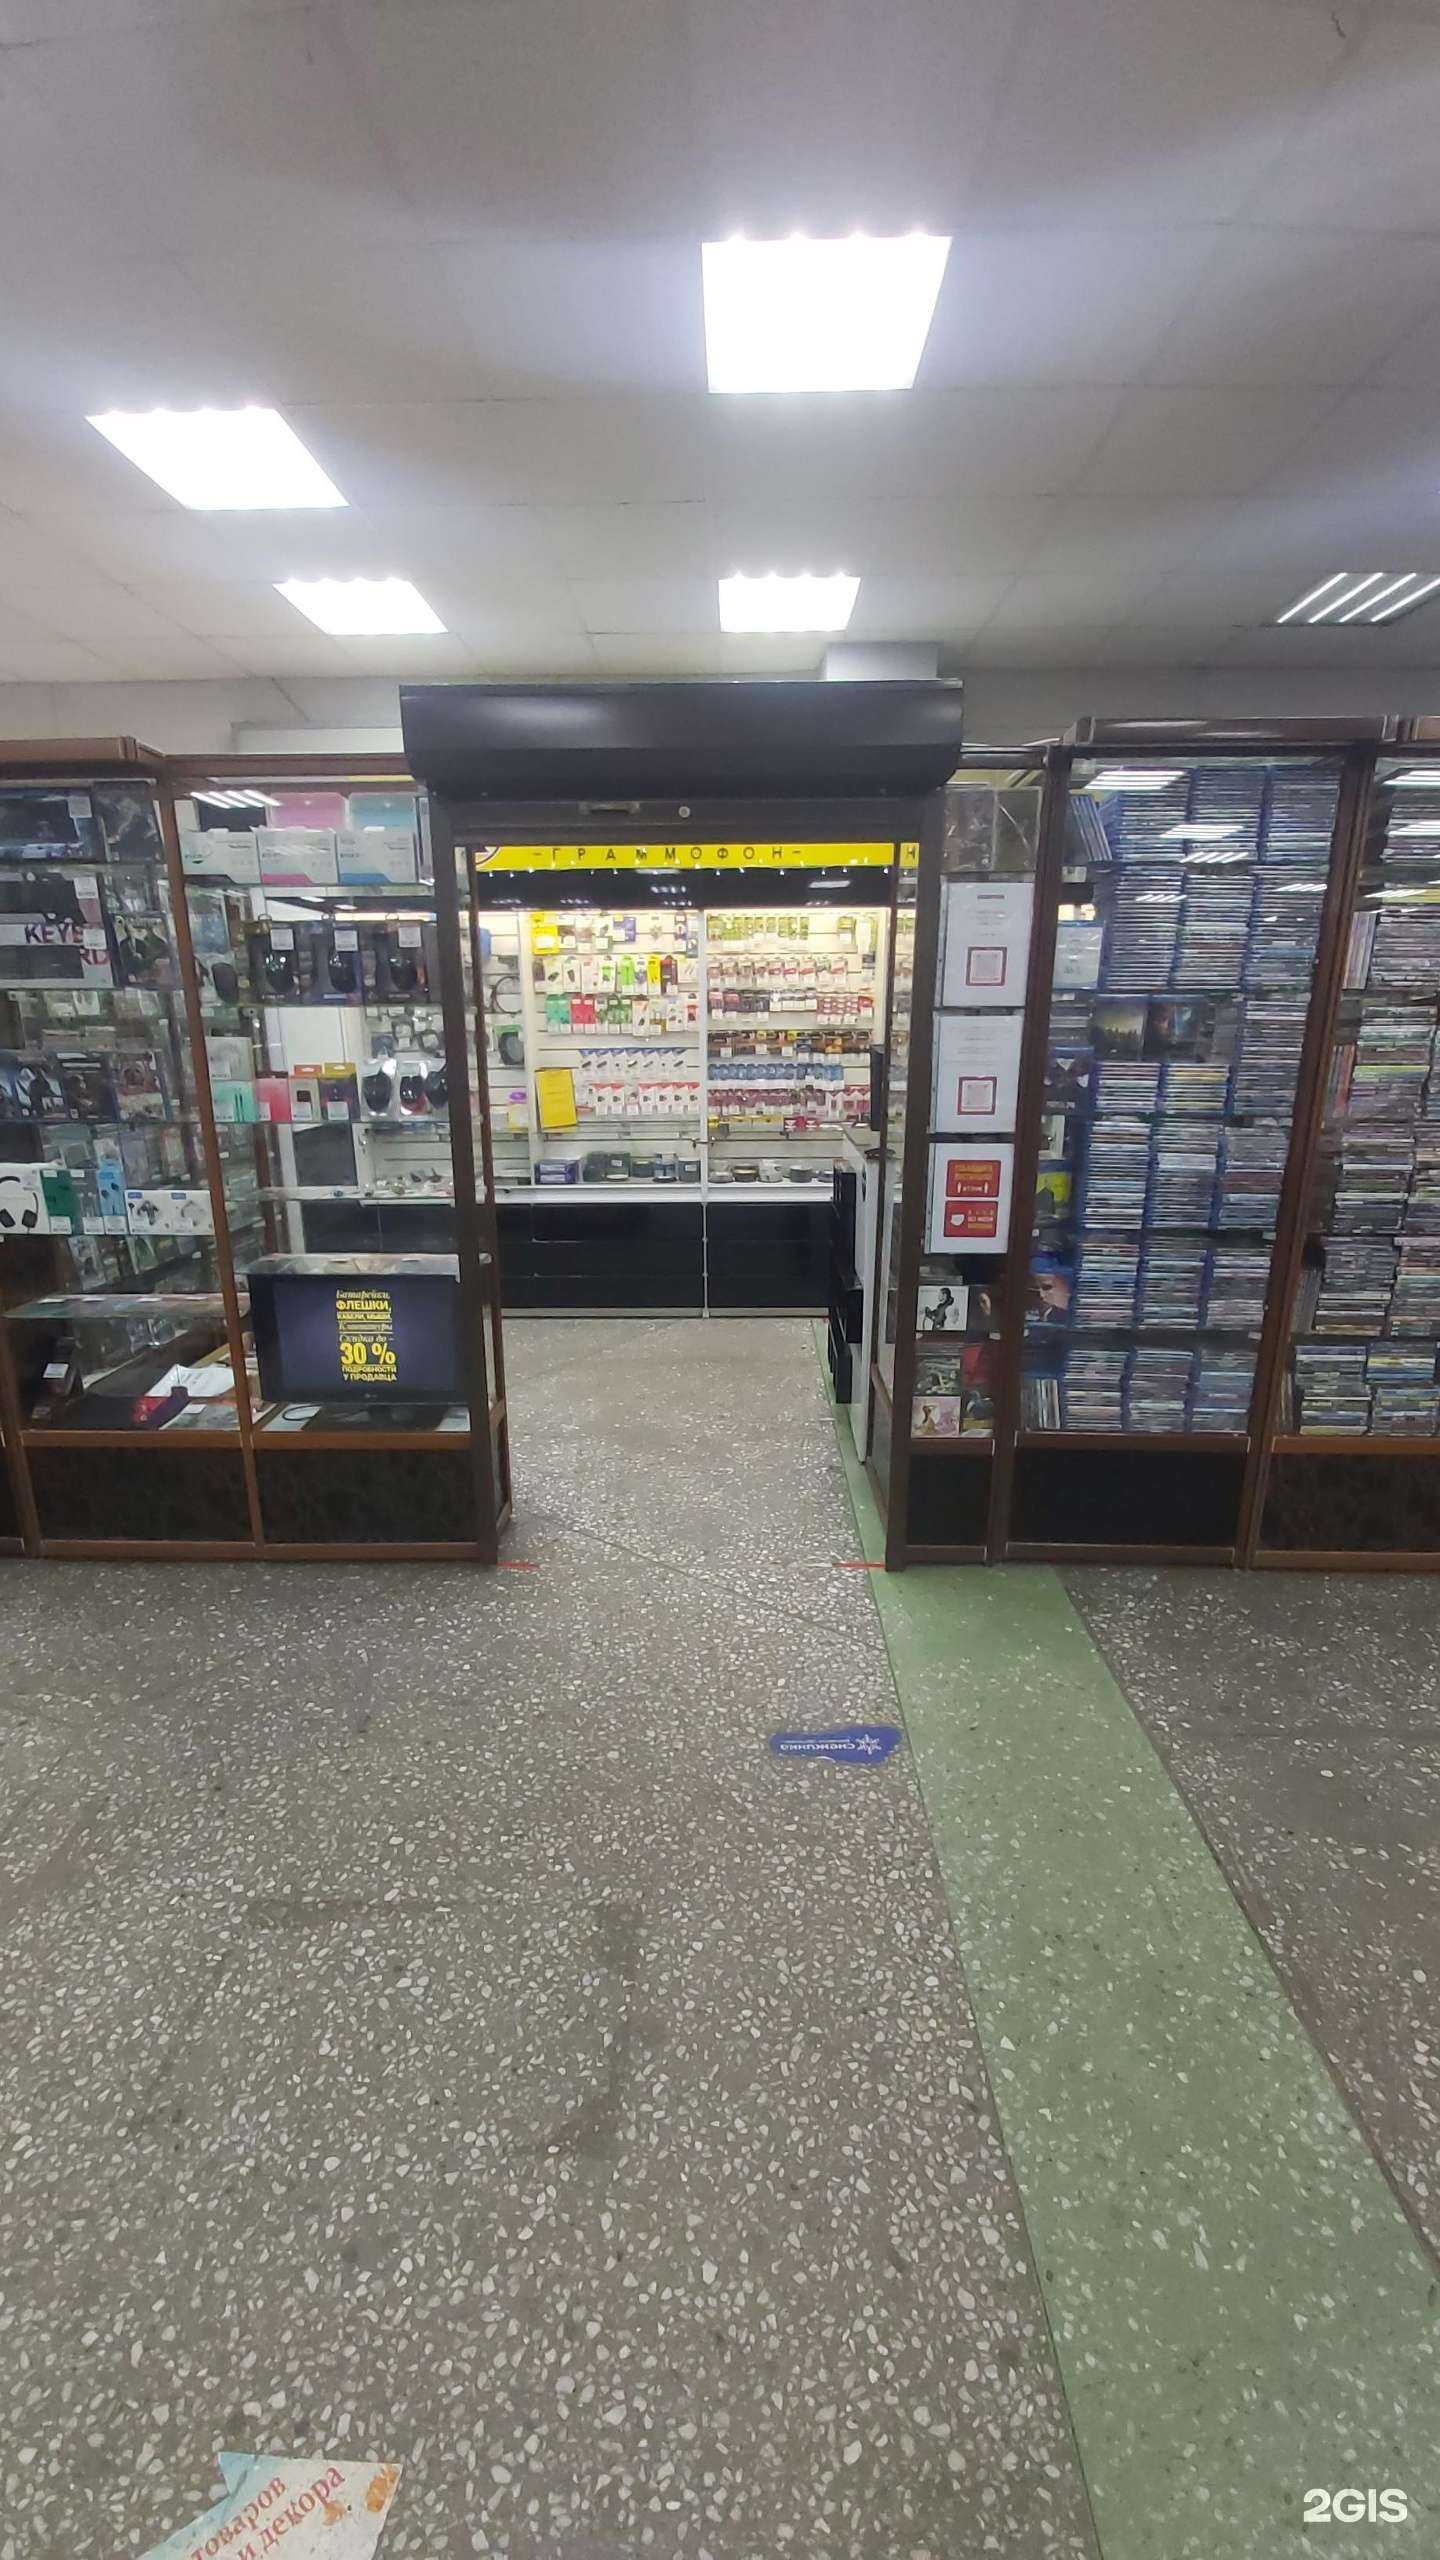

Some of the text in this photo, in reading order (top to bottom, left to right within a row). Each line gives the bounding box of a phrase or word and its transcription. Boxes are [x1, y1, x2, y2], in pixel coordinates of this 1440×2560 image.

[340, 1342, 396, 1364] 30 %
[257, 2466, 346, 2552] декора
